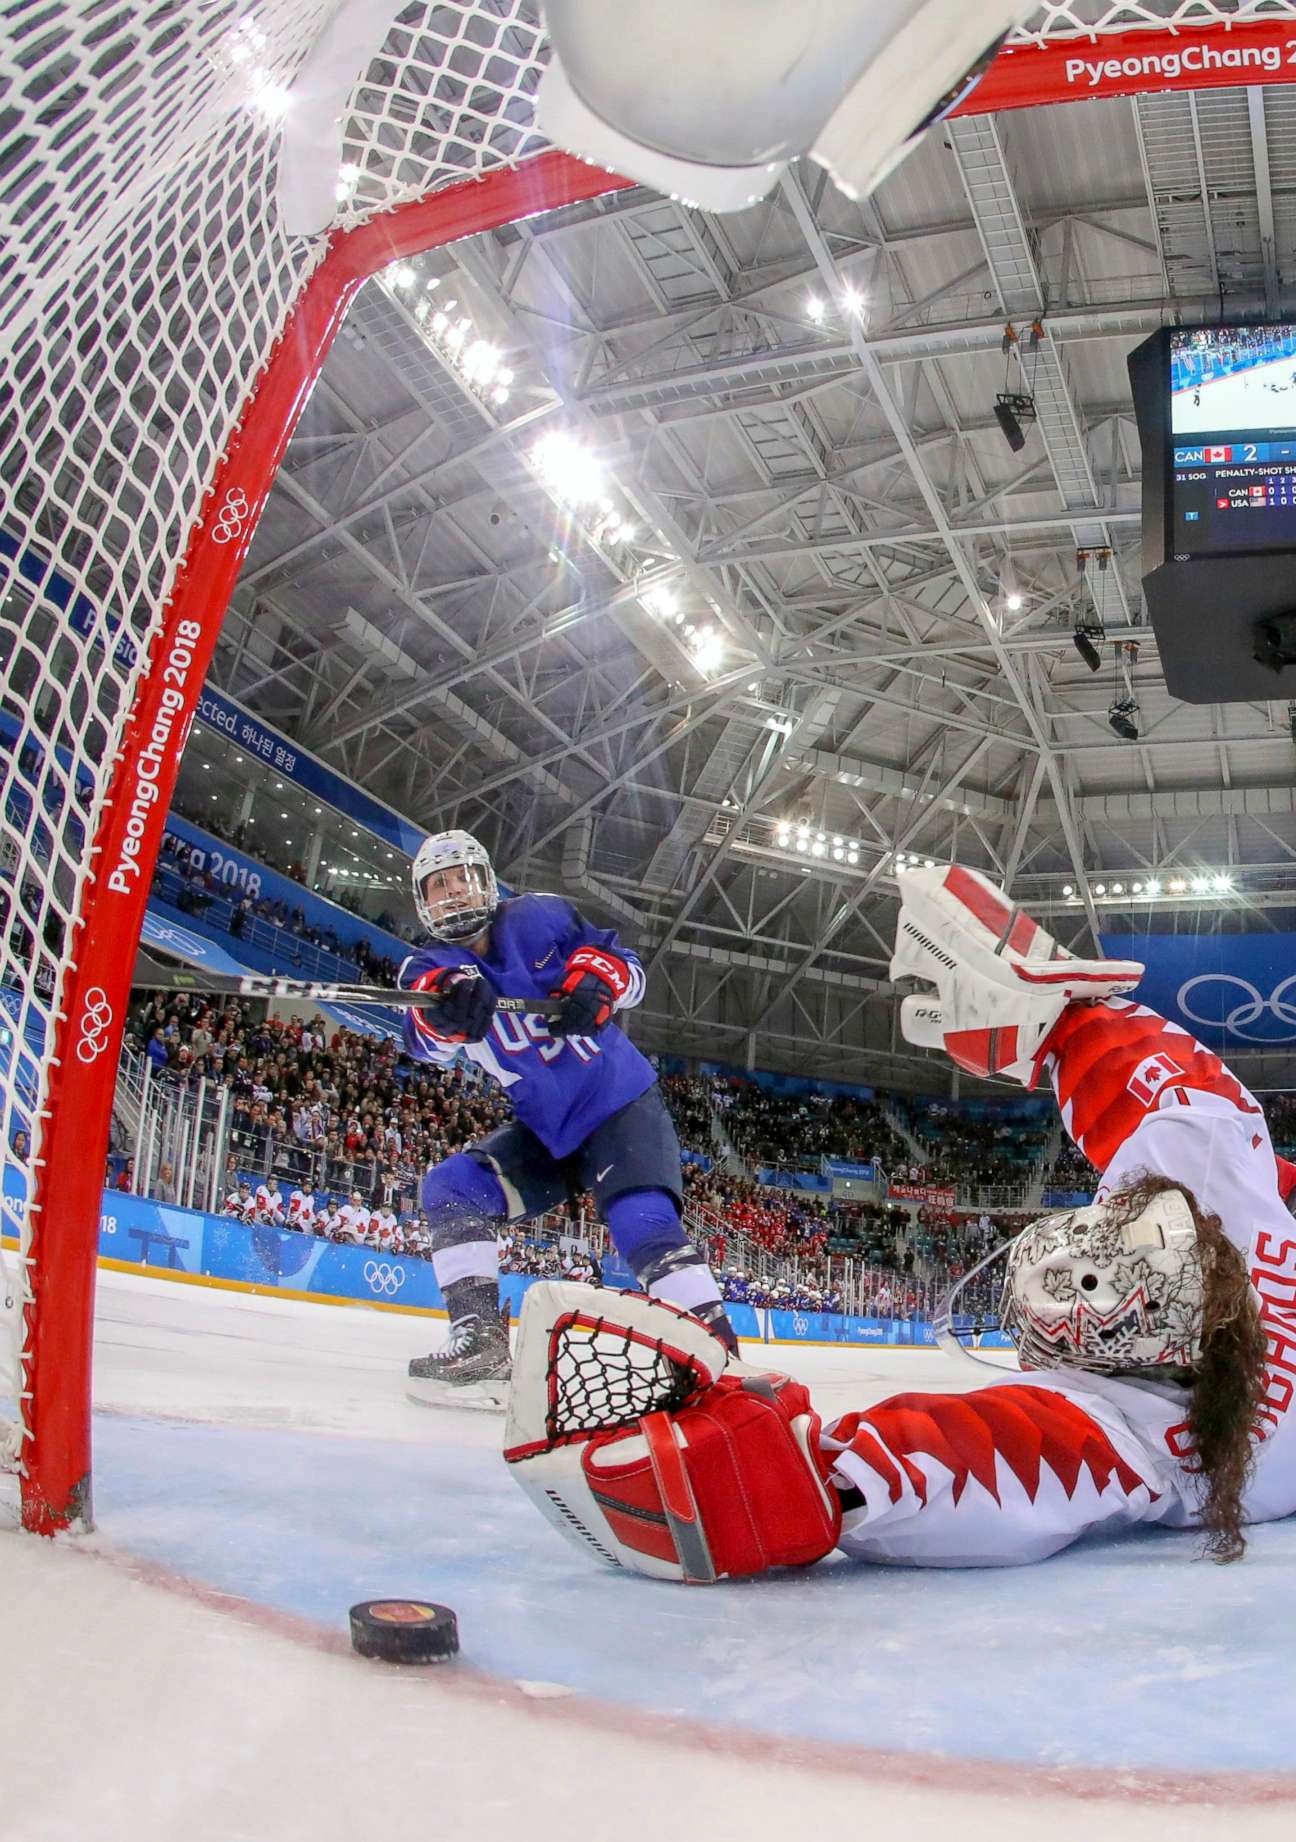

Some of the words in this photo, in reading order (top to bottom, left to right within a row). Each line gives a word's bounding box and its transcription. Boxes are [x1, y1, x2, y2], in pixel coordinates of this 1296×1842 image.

[1065, 45, 1281, 86] PyeongChang
[1174, 450, 1204, 463] CAN
[1243, 444, 1258, 462] 2
[1188, 472, 1207, 480] SOG
[1215, 466, 1282, 478] PENALTY-SHOT
[1228, 488, 1249, 497] CAN
[1230, 499, 1250, 508] USA
[108, 687, 184, 895] PyeongChang
[162, 619, 201, 688] 2018
[242, 723, 273, 758] 하나된
[274, 745, 297, 772] 열정
[210, 851, 262, 899] 2018
[572, 953, 625, 990] CCM
